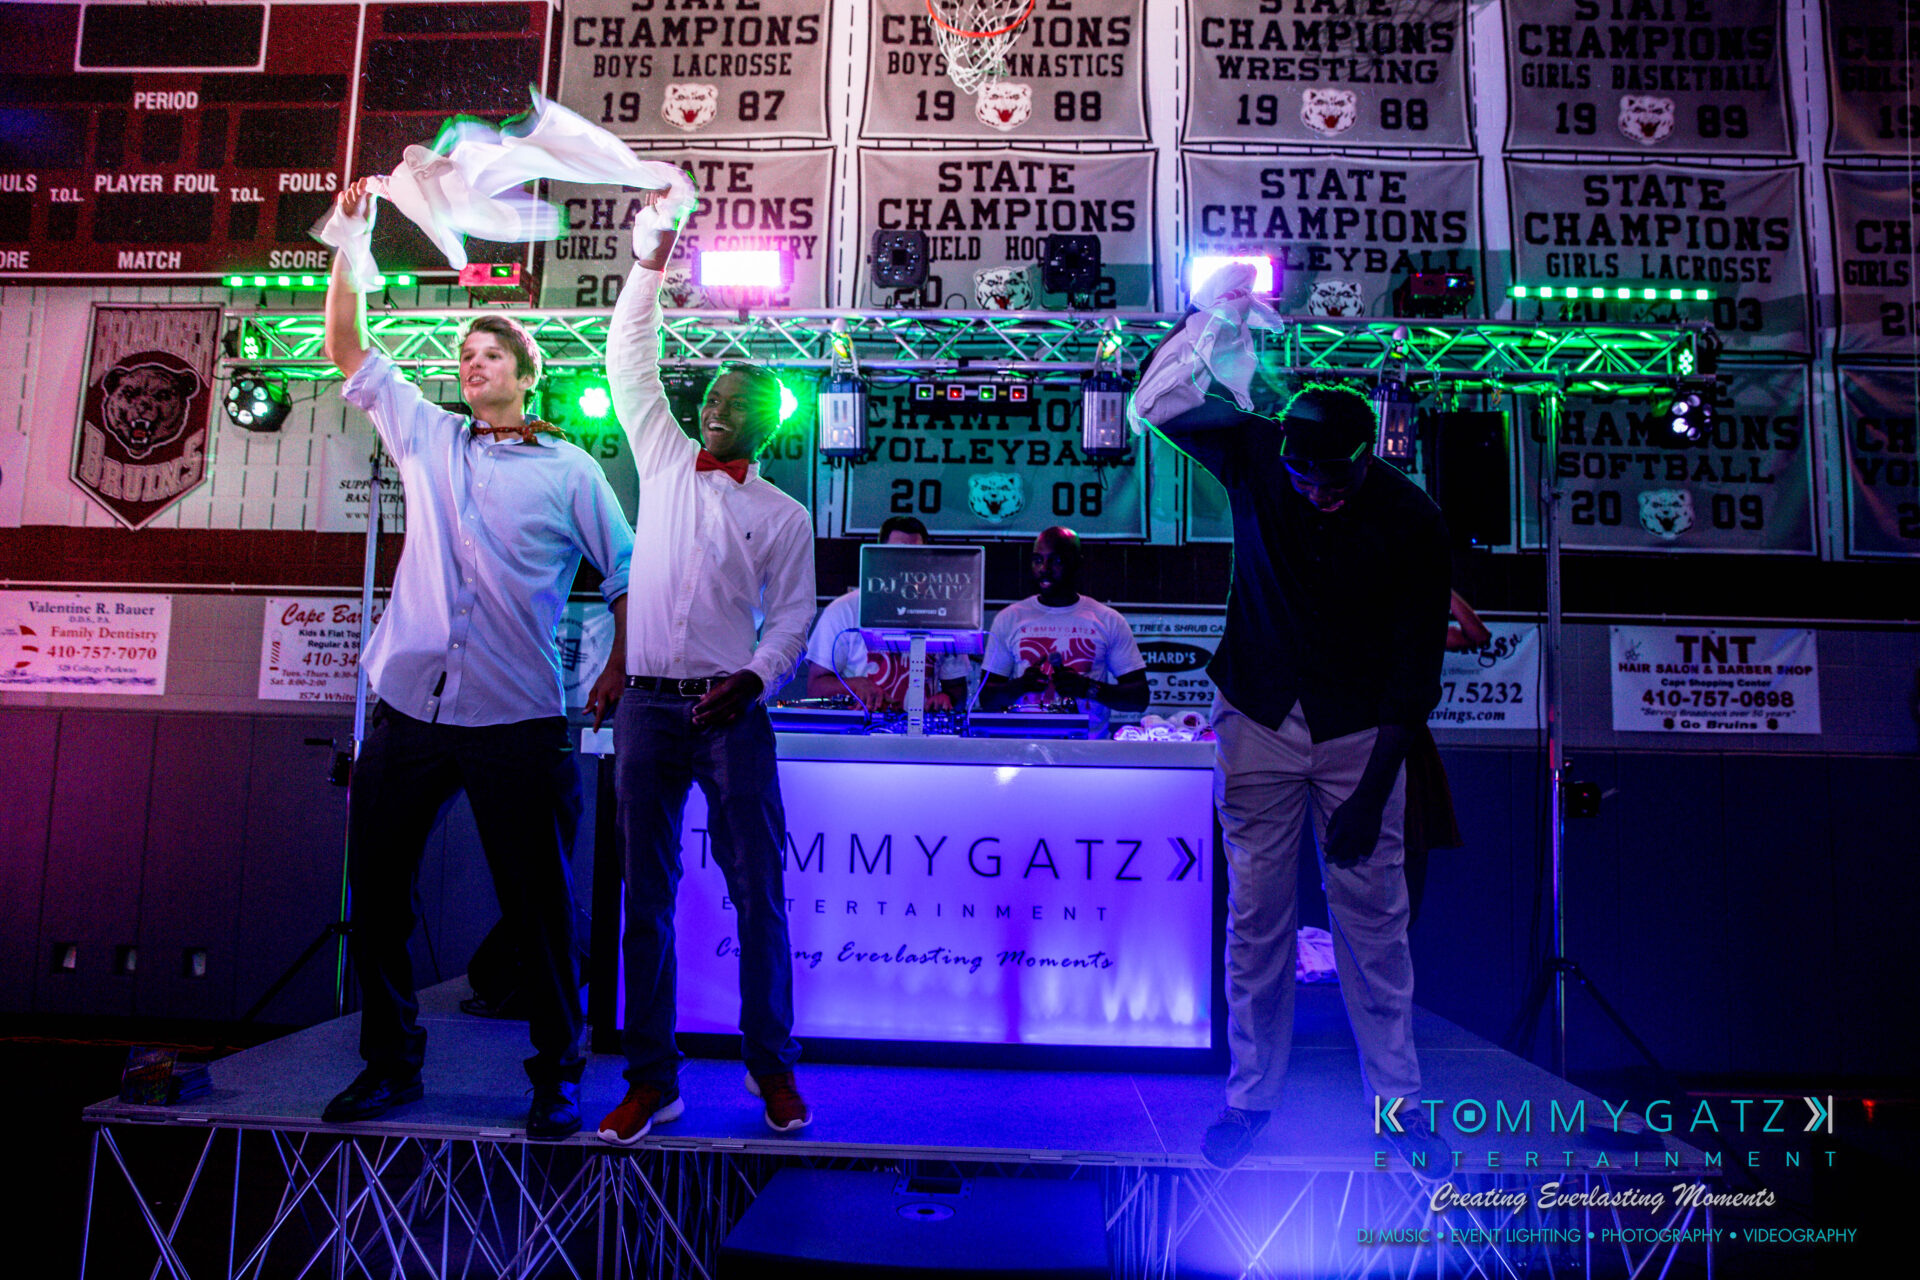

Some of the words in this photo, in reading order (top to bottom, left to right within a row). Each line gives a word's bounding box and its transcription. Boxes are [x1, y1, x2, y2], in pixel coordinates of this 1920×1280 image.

[573, 15, 820, 48] CHAMPIONS
[882, 15, 1131, 48] CHPIONS
[1201, 17, 1454, 54] CHAMPIONS
[1518, 24, 1777, 60] CHAMPIONS
[593, 54, 653, 78] BOYS
[672, 53, 793, 77] LACROSSE
[887, 52, 948, 77] BOYS
[1217, 55, 1438, 83] WRESTLING
[1522, 64, 1590, 88] GIRLS
[1612, 65, 1770, 90] BASKETBALL
[133, 91, 199, 110] PERIOD
[601, 92, 641, 123] 19
[738, 90, 786, 121] 87
[915, 90, 955, 121] 19
[1054, 91, 1101, 121] 88
[1237, 94, 1277, 125] 19
[1381, 98, 1428, 130] 88
[1556, 103, 1596, 134] 19
[1697, 105, 1748, 137] 89
[0, 174, 38, 193] ULS
[94, 174, 163, 193] PLAYER
[174, 174, 220, 193] FOUL
[278, 173, 338, 192] FOULS
[939, 161, 1074, 193] STATE
[1261, 168, 1407, 203] STATE
[1584, 175, 1726, 211] STATE
[564, 198, 814, 230] CHAPIONS
[878, 199, 1135, 231] CHAMPIONS
[1202, 205, 1467, 243] CHAMPIONS
[1525, 212, 1790, 251] CHAMPIONS
[117, 251, 181, 269] MATCH
[269, 251, 329, 269] SCORE
[556, 236, 618, 259] GIRLS
[926, 236, 980, 261] IELD
[1546, 253, 1618, 277] GIRLS
[1642, 254, 1772, 282] LACROSSE
[1844, 260, 1909, 287] GIRLS
[1712, 297, 1762, 331] 03
[79, 420, 205, 502] BRUINS
[1557, 452, 1774, 483] SOFTBALL
[891, 479, 941, 513] 20
[1053, 482, 1102, 516] 08
[1571, 491, 1621, 525] 20
[1712, 494, 1764, 529] 09
[866, 577, 897, 593] DJ
[900, 571, 973, 584] TOMMY
[28, 601, 91, 614] Valentine
[96, 602, 110, 615] R.
[115, 603, 155, 616] Bauer
[281, 603, 326, 627] Cape
[51, 626, 94, 641] Family
[99, 627, 158, 643] Dentistry
[299, 629, 317, 637] Kids
[328, 630, 344, 638] Flat
[1140, 624, 1163, 632] TREE
[308, 640, 340, 649] Regular
[1676, 635, 1756, 663] TNT
[1167, 675, 1210, 687] Care
[1619, 663, 1650, 673] HAIR
[1656, 664, 1698, 674] SALON
[1704, 665, 1713, 674] &
[1718, 665, 1772, 675] BARBER
[1778, 666, 1812, 675] SHOP
[1443, 682, 1523, 703] 7.5232
[1661, 679, 1685, 688] Cape
[1689, 679, 1734, 688] Shopping
[1642, 689, 1795, 707] 410-757-0698
[1681, 720, 1700, 729] Go
[1707, 720, 1757, 729] Bruins
[691, 828, 1143, 881] TMMYGATZ
[722, 896, 1108, 921] ETERTAINMENT
[837, 941, 984, 973] Everlasting
[1000, 949, 1113, 970] Moments
